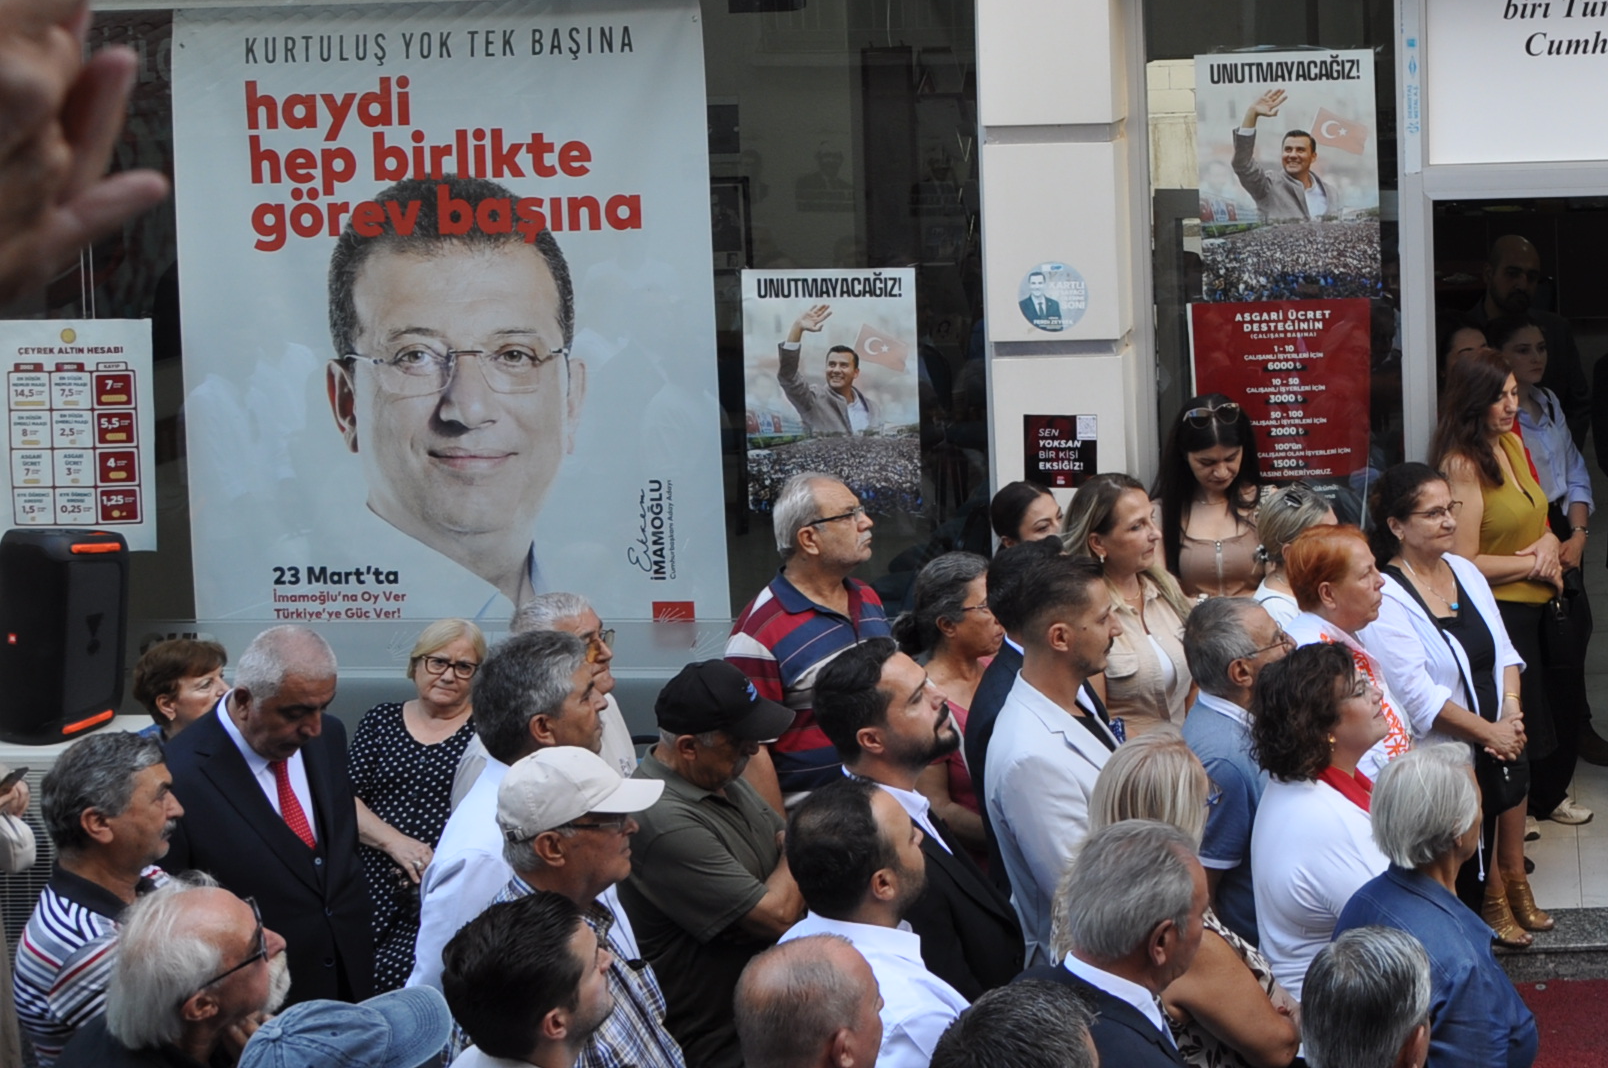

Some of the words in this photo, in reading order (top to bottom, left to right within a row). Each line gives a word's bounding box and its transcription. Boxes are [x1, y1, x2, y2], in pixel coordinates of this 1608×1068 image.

[244, 34, 388, 66] KURTULUŞ
[402, 31, 453, 61] YOK
[467, 29, 517, 58] TEK
[531, 25, 635, 59] BAŞINA
[1208, 53, 1361, 86] UNUTMAYACAĞIZ!
[244, 75, 411, 141] haydi
[249, 135, 357, 195] hep
[373, 129, 592, 182] birlikte
[250, 186, 420, 252] görev
[436, 184, 643, 243] başına
[757, 272, 902, 299] UNUTMAYACAĞIZ!
[1235, 311, 1283, 322] ASGARİ
[1288, 309, 1331, 320] ÜCRET
[1243, 320, 1323, 332] DESTEĞİNİN
[18, 347, 55, 356] ÇEYREK
[58, 346, 85, 355] ALTIN
[87, 346, 124, 354] HESABI
[1267, 362, 1294, 370] 6000
[104, 379, 113, 390] 7
[14, 388, 34, 399] 14,5
[60, 388, 74, 398] 7,5
[1269, 394, 1296, 403] 3000
[1289, 410, 1303, 418] 100
[100, 418, 120, 429] 5,5
[60, 428, 75, 437] 2,5
[1038, 428, 1060, 437] SEN
[1271, 427, 1297, 436] 2000
[1039, 440, 1082, 448] YOKSAN
[1039, 449, 1056, 459] BİR
[1059, 449, 1079, 460] KİŞİ
[107, 457, 116, 468] 4
[1038, 460, 1084, 471] EKSİĞİZ!
[1273, 459, 1297, 467] 1500
[24, 468, 30, 476] 7
[66, 467, 72, 476] 3
[102, 496, 124, 506] 1,25
[22, 505, 35, 514] 1,5
[60, 505, 82, 514] 0,25
[668, 502, 676, 521] Aday
[648, 479, 666, 581] İMAMOĞLU
[273, 566, 300, 585] 23
[307, 565, 399, 584] Mart'ta
[273, 588, 358, 605] İmamoğlu'na
[361, 591, 379, 604] Oy
[383, 591, 406, 602] Ver
[274, 608, 342, 621] Türkiye'ye
[373, 608, 401, 618] Ver!
